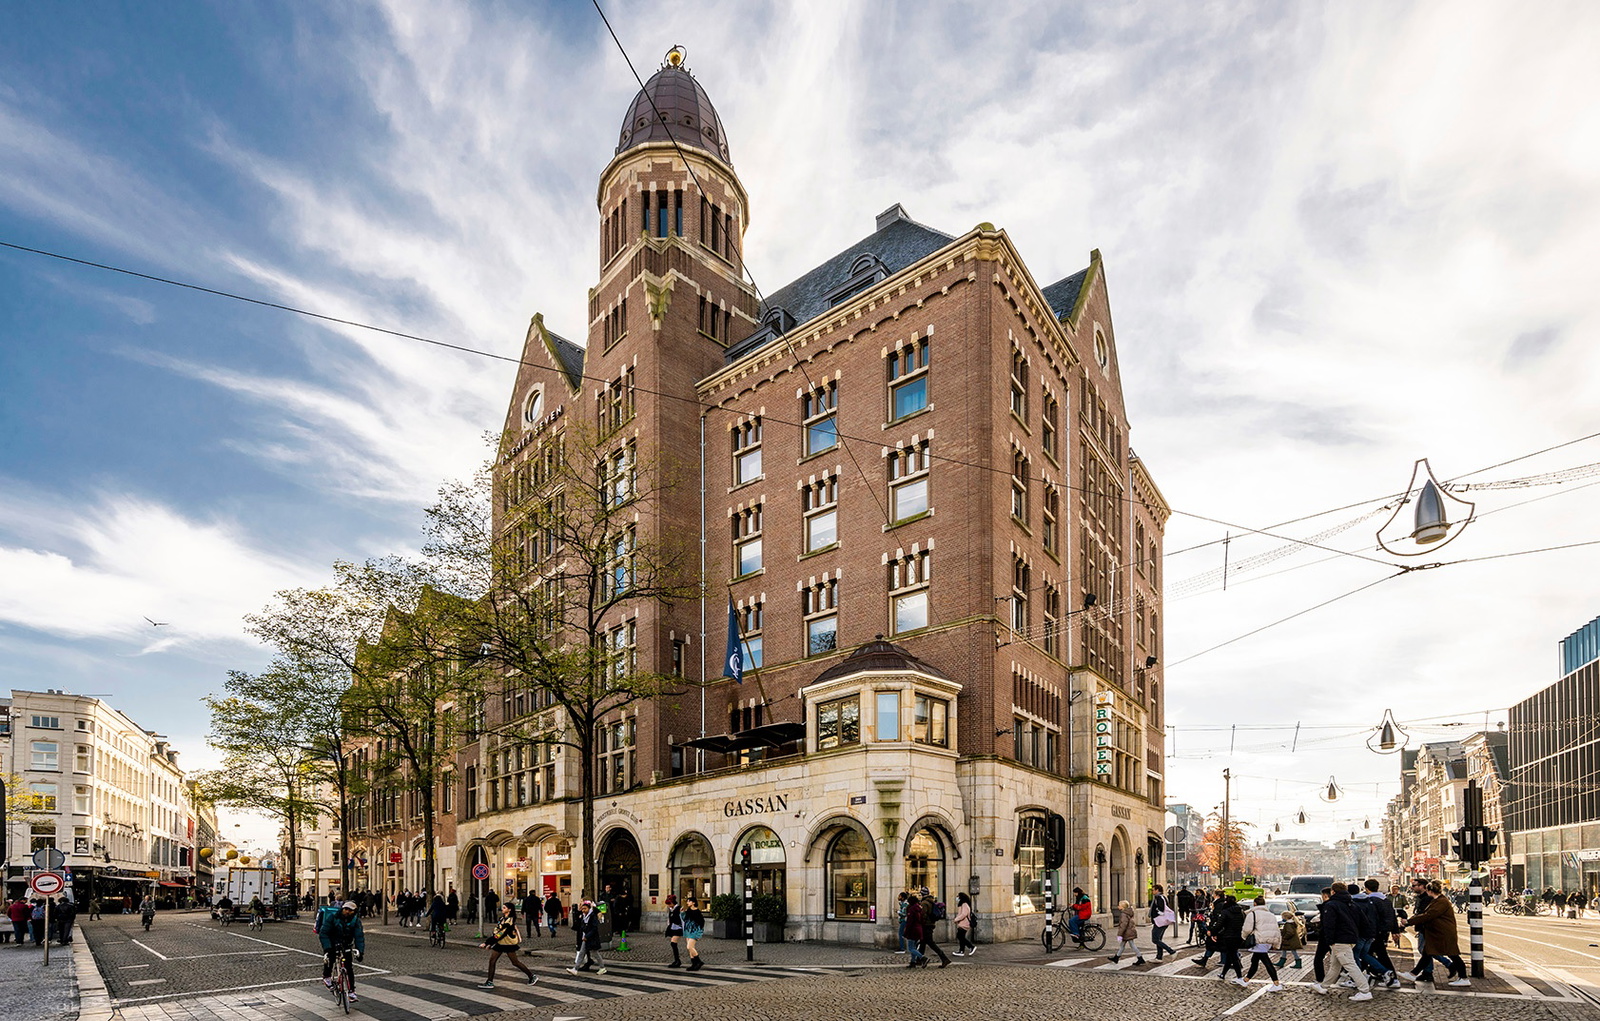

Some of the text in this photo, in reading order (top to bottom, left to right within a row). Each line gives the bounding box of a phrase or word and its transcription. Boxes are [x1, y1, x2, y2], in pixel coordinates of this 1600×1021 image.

[534, 404, 564, 437] SEVEN
[1096, 709, 1108, 774] ROLEX
[724, 794, 788, 818] GASSAN
[755, 840, 781, 849] ROLEX
